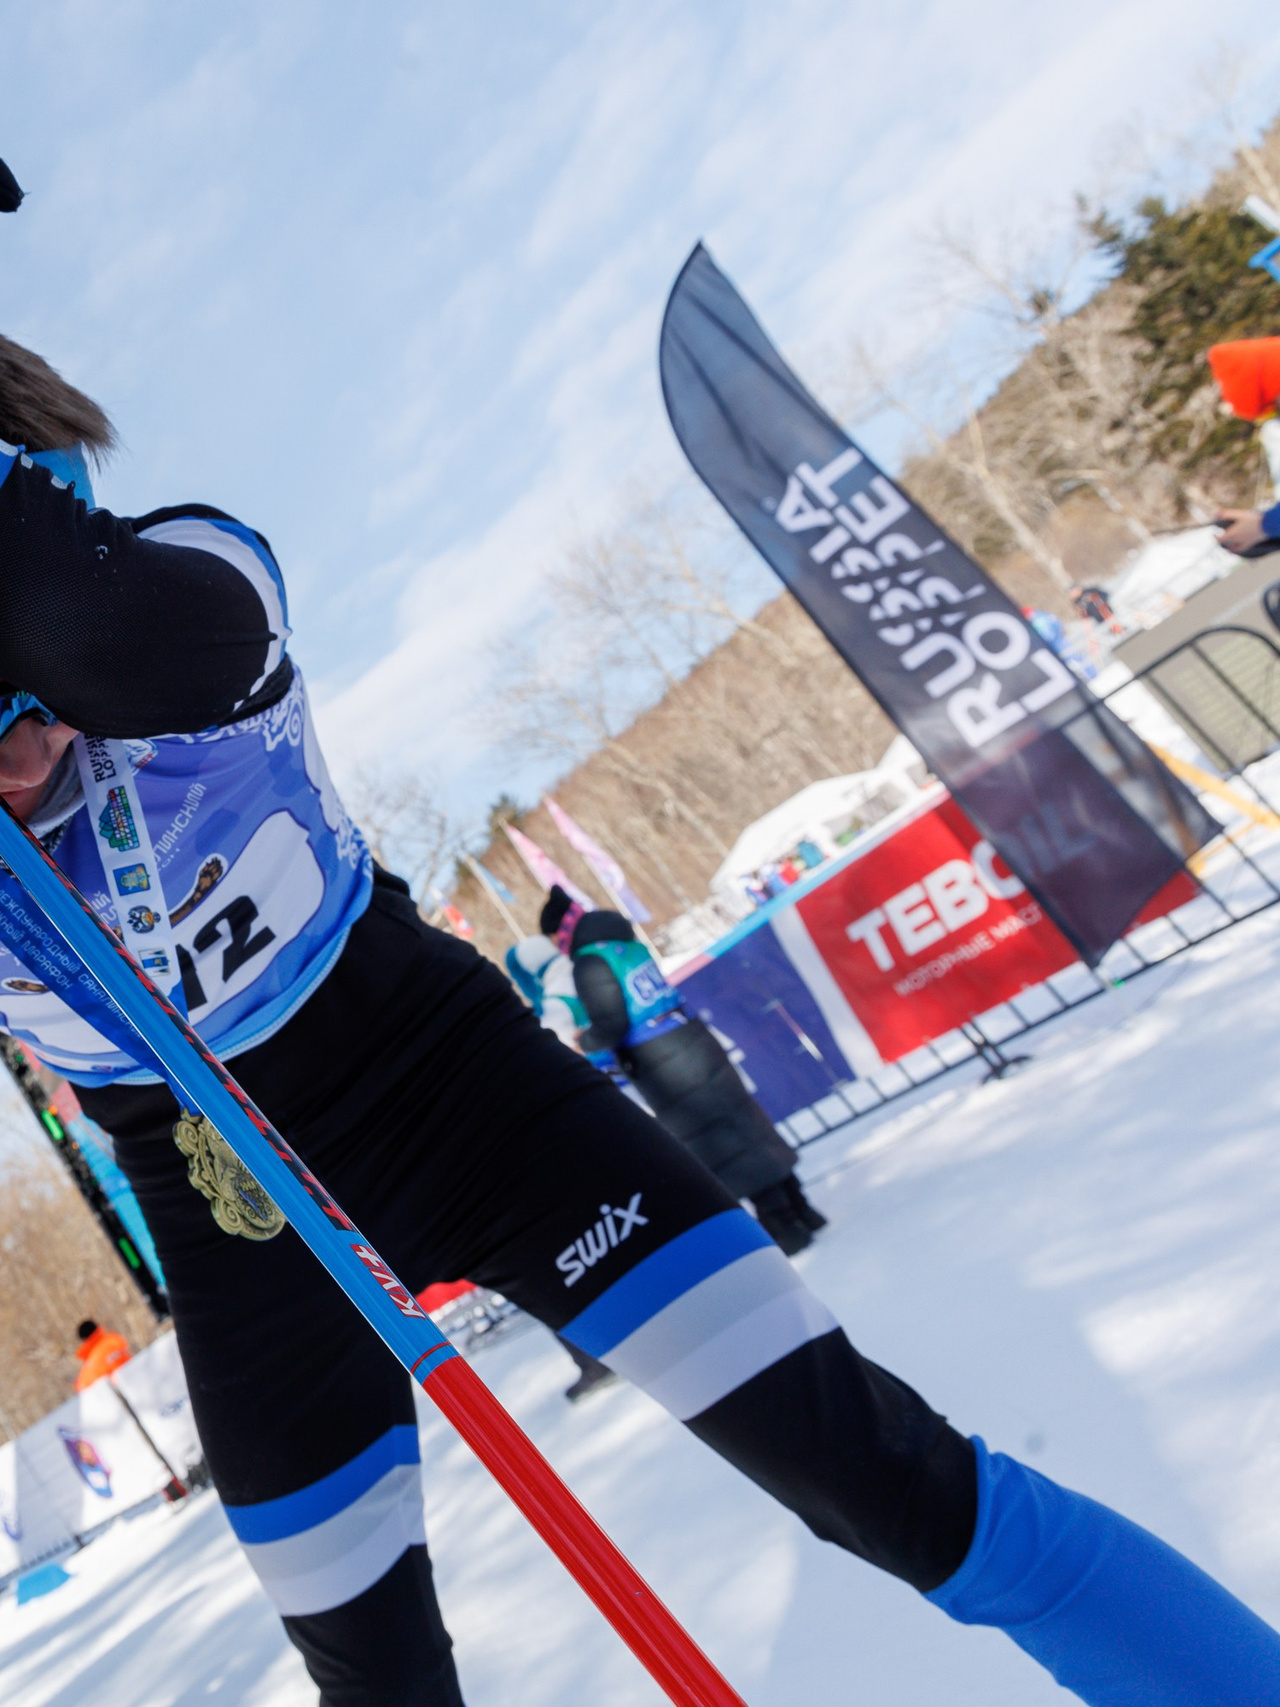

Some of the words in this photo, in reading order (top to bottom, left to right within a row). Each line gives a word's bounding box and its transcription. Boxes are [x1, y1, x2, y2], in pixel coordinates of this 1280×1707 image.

[775, 473, 1028, 748] RUSSIA
[793, 447, 1077, 713] LOPPET
[21, 939, 74, 991] МАРАФОН
[555, 1192, 649, 1288] swix
